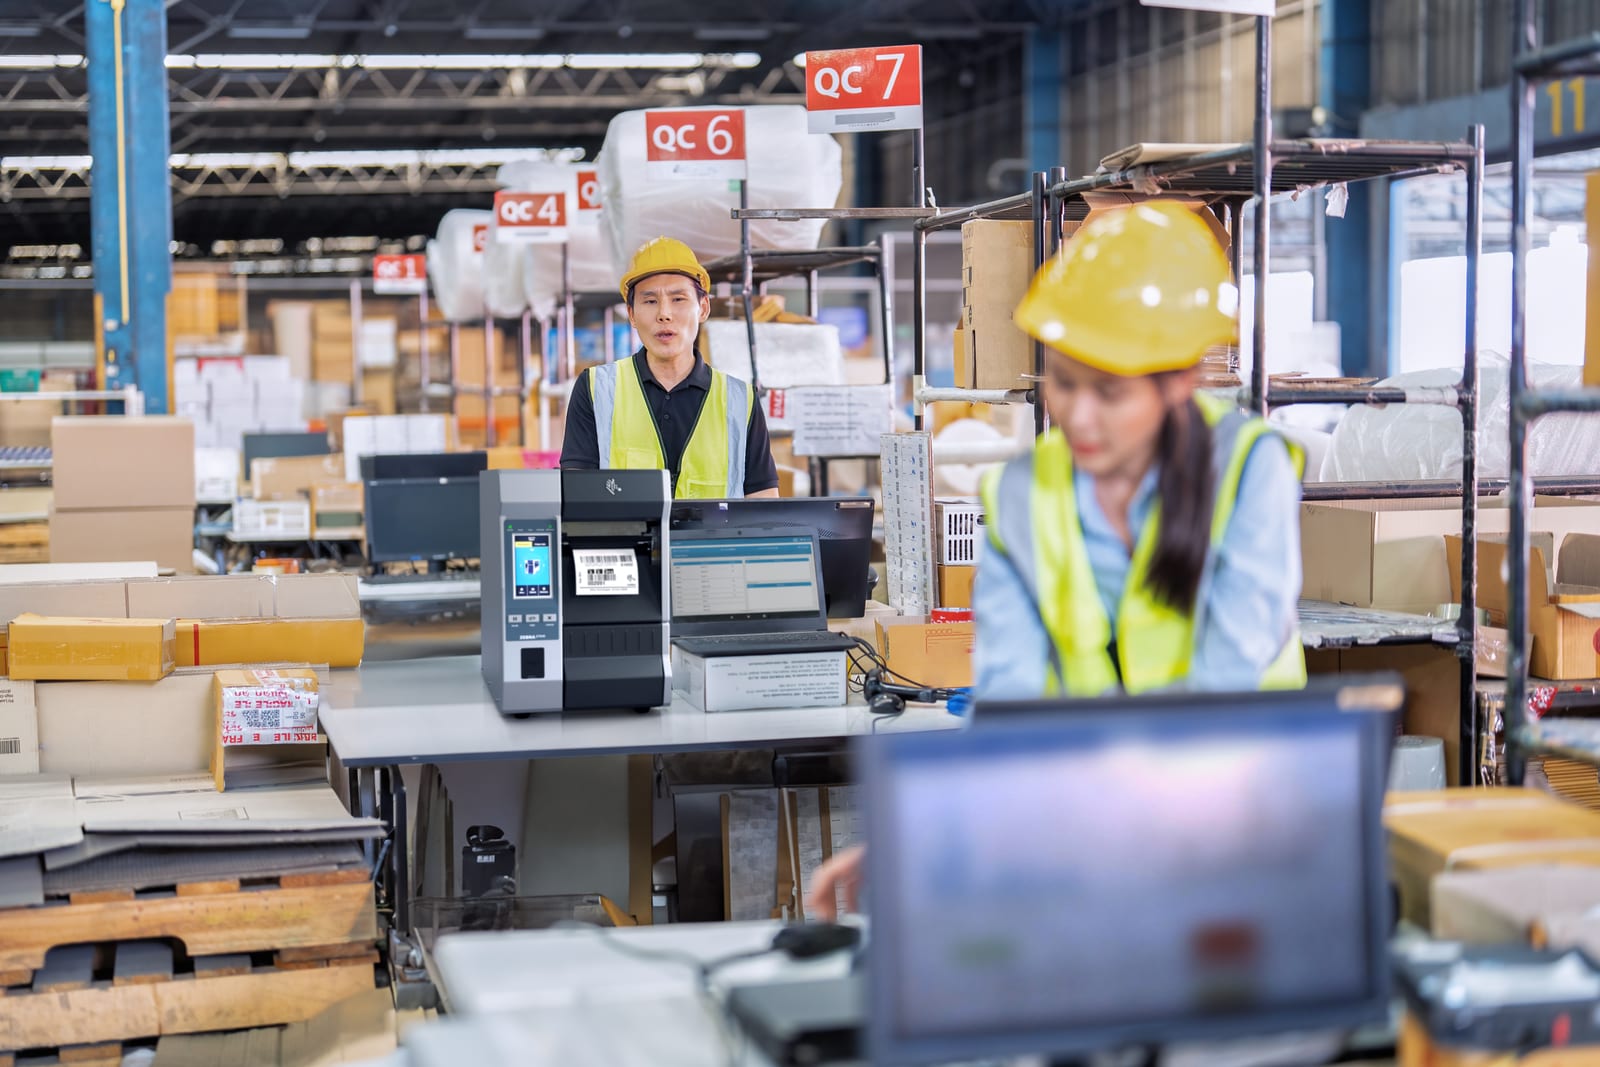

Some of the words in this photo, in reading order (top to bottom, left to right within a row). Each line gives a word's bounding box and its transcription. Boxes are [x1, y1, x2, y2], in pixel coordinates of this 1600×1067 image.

[814, 65, 862, 98] QC
[876, 53, 905, 99] 7
[1546, 76, 1585, 137] 11
[653, 124, 696, 152] QC
[706, 115, 733, 155] 6
[500, 201, 533, 223] QC
[537, 195, 560, 224] 4
[581, 180, 602, 207] Q
[405, 257, 417, 278] 1
